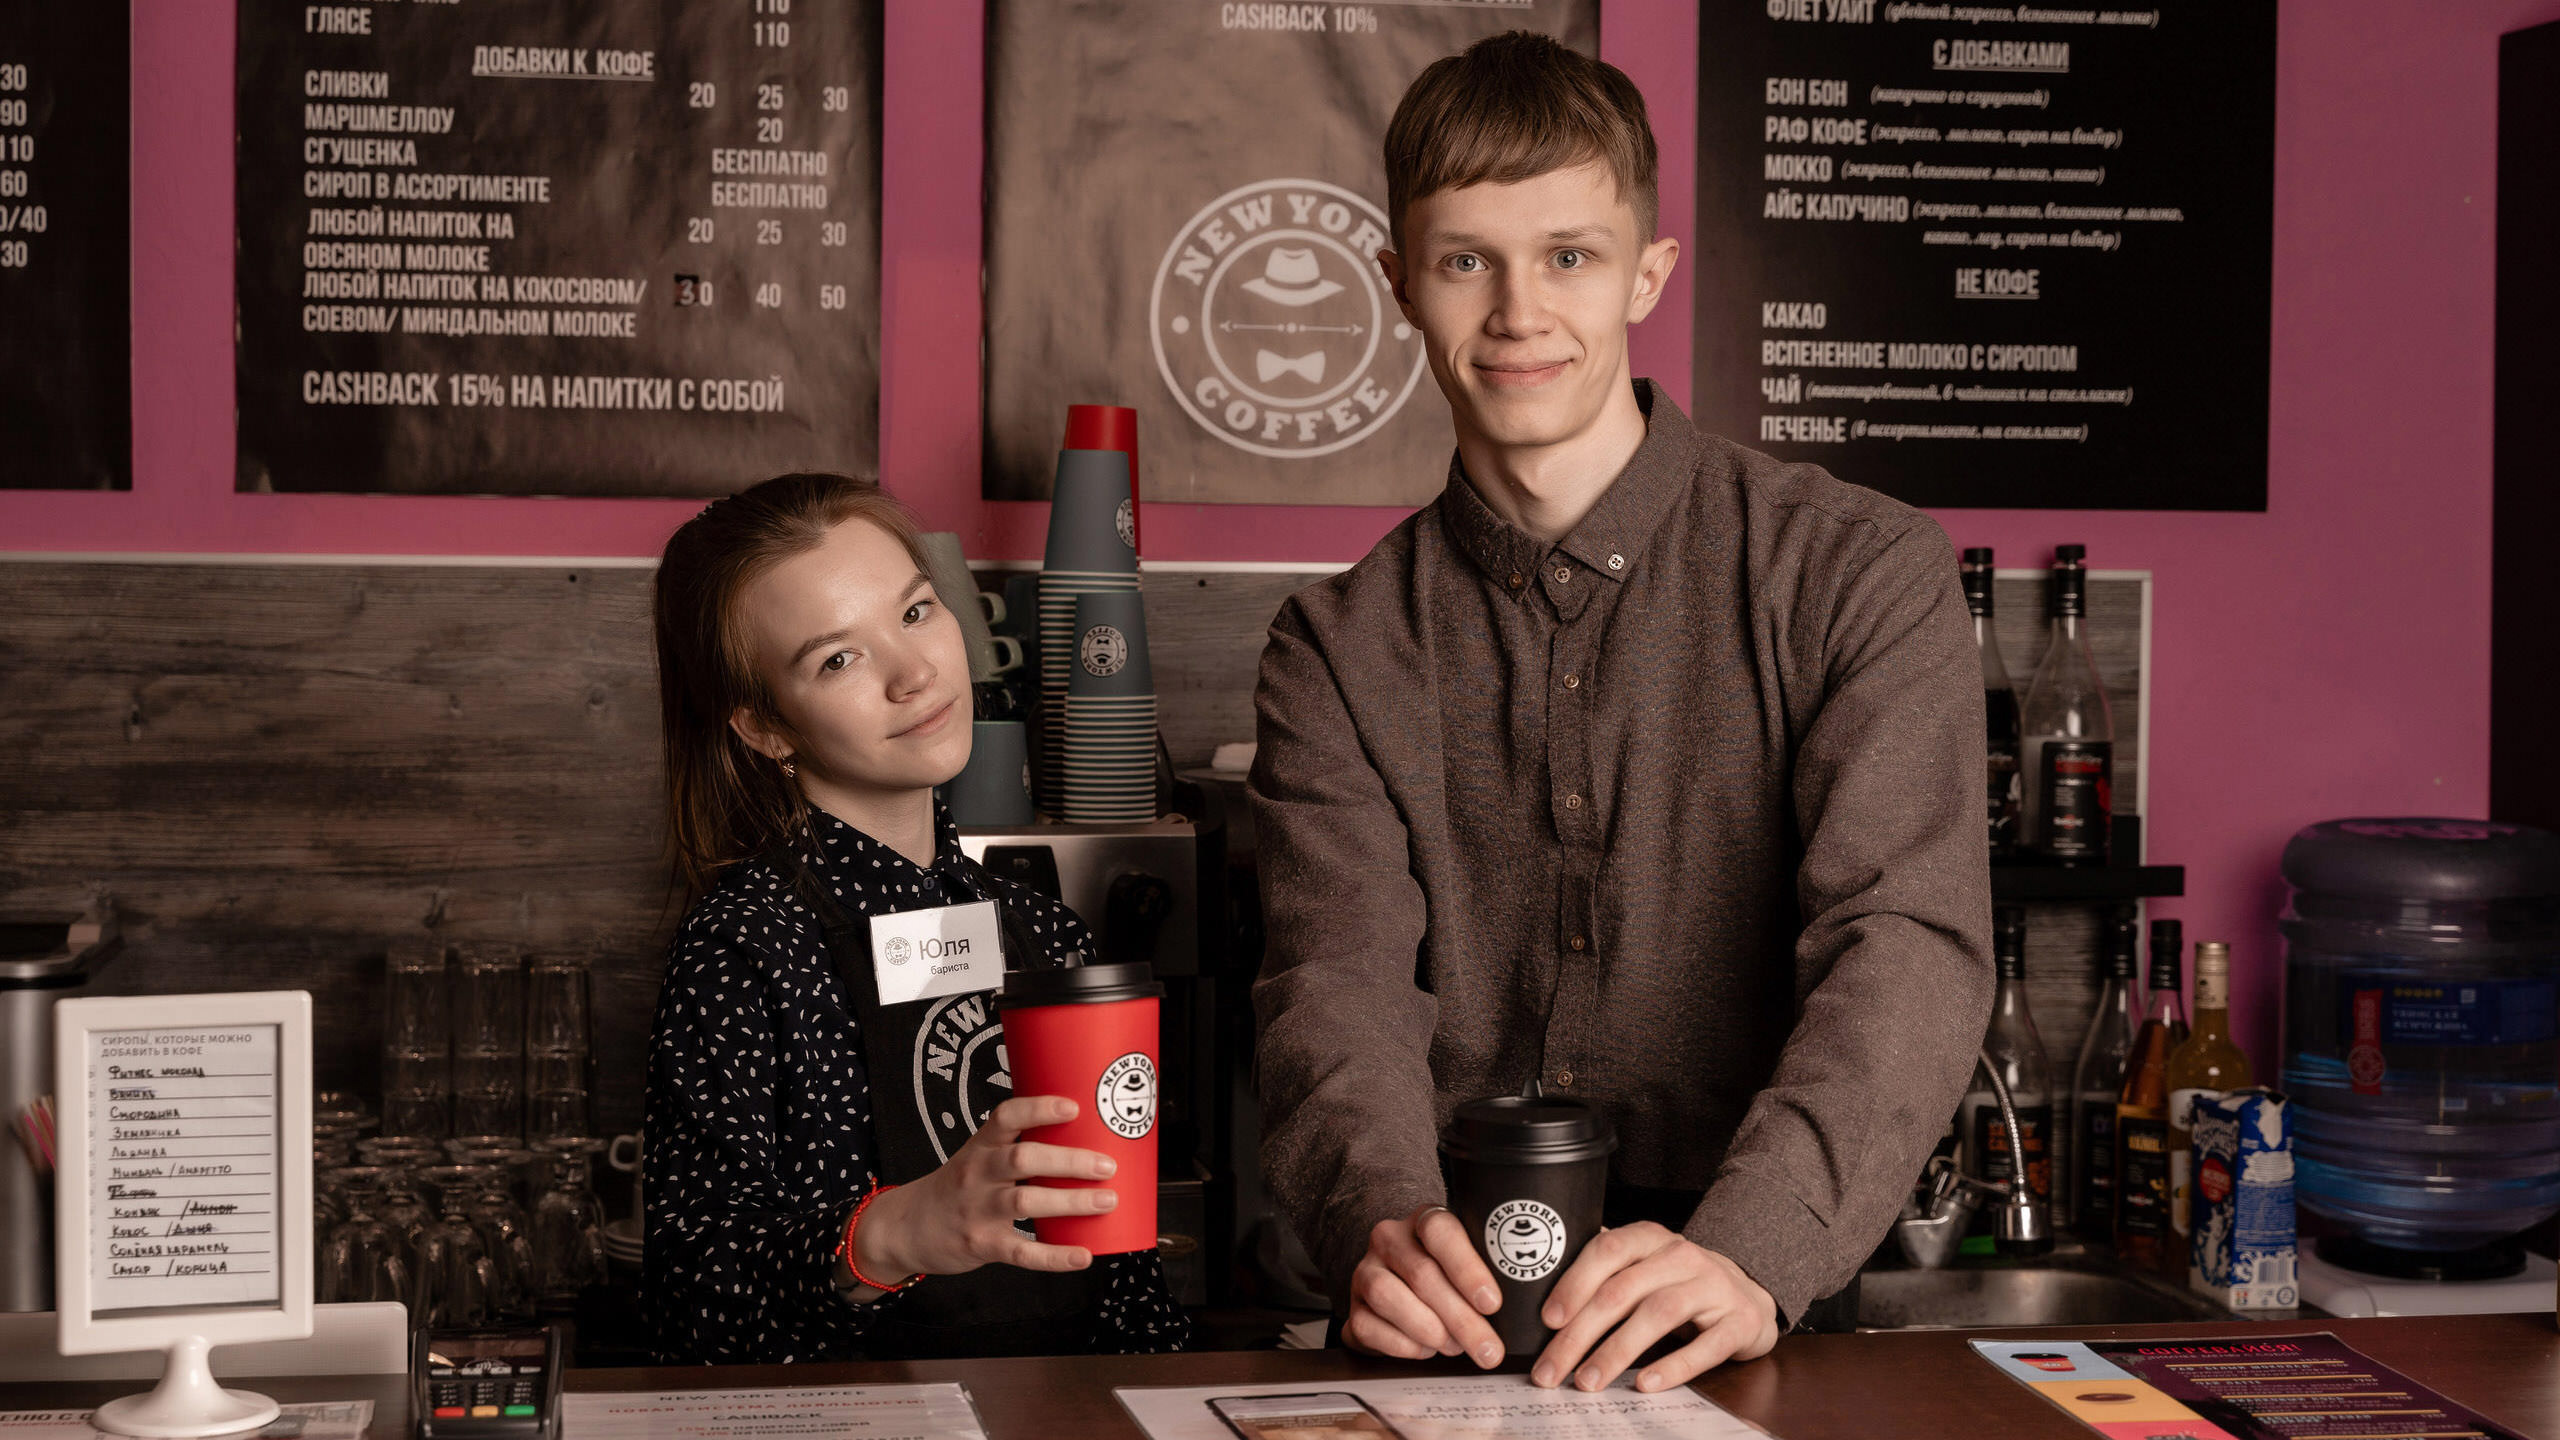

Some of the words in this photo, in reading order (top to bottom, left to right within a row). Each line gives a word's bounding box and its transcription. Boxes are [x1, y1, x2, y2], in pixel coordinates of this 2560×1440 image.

[304, 6, 371, 35] ГЛЯСЕ
[1221, 3, 1326, 32] CASHBACK
[1334, 5, 1378, 34] 10%
[1766, 0, 1822, 22] ФЛЕТ
[753, 21, 790, 47] 110
[473, 46, 570, 75] ДОБАВКИ
[573, 49, 587, 74] К
[596, 49, 654, 78] КОФЕ
[1933, 39, 1947, 66] С
[1951, 40, 2069, 69] ДОБАВКАМИ
[304, 70, 389, 98] СЛИВКИ
[689, 83, 716, 109] 20
[758, 85, 784, 111] 25
[1766, 78, 1805, 105] БОН
[1809, 80, 1847, 106] БОН
[823, 86, 849, 112] 30
[304, 104, 455, 134] МАРШМЕЛЛОУ
[757, 117, 784, 143] 20
[1765, 116, 1808, 143] РАФ
[1812, 118, 1867, 146] КОФЕ
[304, 137, 417, 167] СГУЩЕНКА
[712, 148, 828, 177] БЕСПЛАТНО
[1765, 154, 1832, 182] МОККО
[0, 170, 28, 197] 60
[304, 171, 371, 199] СИРОП
[375, 173, 390, 199] В
[393, 173, 551, 203] АССОРТИМЕНТЕ
[711, 181, 828, 210] БЕСПЛАТНО
[1764, 189, 1804, 220] АЙС
[1806, 194, 1909, 223] КАПУЧИНО
[307, 205, 382, 237] ЛЮБОЙ
[388, 211, 482, 239] НАПИТОК
[486, 212, 514, 240] НА
[688, 217, 715, 244] 20
[757, 220, 783, 246] 25
[821, 221, 847, 247] 30
[1173, 194, 1273, 287] NEW
[303, 242, 401, 270] ОВСЯНОМ
[406, 243, 490, 272] МОЛОКЕ
[302, 270, 380, 300] ЛЮБОЙ
[383, 275, 477, 303] НАПИТОК
[481, 276, 510, 303] НА
[513, 276, 647, 305] КОКОСОВОМ/
[680, 279, 713, 306] 30
[756, 282, 782, 308] 40
[1956, 268, 1981, 295] НЕ
[1985, 269, 2039, 296] КОФЕ
[820, 283, 846, 310] 50
[303, 305, 397, 332] СОЕВОМ/
[402, 308, 549, 337] МИНДАЛЬНОМ
[553, 310, 636, 337] МОЛОКЕ
[1762, 302, 1826, 329] КАКАО
[1762, 341, 1885, 369] ВСПЕНЕННОЕ
[1888, 343, 1967, 370] МОЛОКО
[1970, 345, 1984, 370] С
[1988, 345, 2077, 371] СИРОПОМ
[302, 371, 438, 404] CASHBACK
[448, 374, 506, 407] 15%
[511, 375, 546, 408] НА
[552, 377, 672, 410] НАПИТКИ
[678, 378, 696, 410] С
[700, 375, 784, 412] СОБОЙ
[1762, 373, 1801, 403] ЧАЙ
[1195, 376, 1389, 442] COFFEE
[1761, 416, 1846, 443] ПЕЧЕНЬЕ
[919, 938, 970, 960] Юля
[930, 962, 970, 975] бариста
[101, 1047, 159, 1058] ДОБАВИТЬ
[172, 1046, 203, 1056] КОФЕ
[154, 1035, 206, 1045] КОТОРЫЕ
[208, 1034, 252, 1044] МОЖНО
[927, 994, 986, 1082] NEW
[1103, 1058, 1130, 1087] NEW
[1133, 1056, 1156, 1082] YORK
[1489, 1203, 1515, 1231] NEW
[1519, 1202, 1560, 1229] YORK
[1498, 1254, 1558, 1278] COFFEE
[2138, 1342, 2303, 1355] СОГРЕВАЙСЯ!
[712, 1413, 824, 1421] CASHBACK
[1425, 1405, 1520, 1414] Дарим
[1526, 1399, 1652, 1409] подарки!
[1521, 1408, 1591, 1416] 5000
